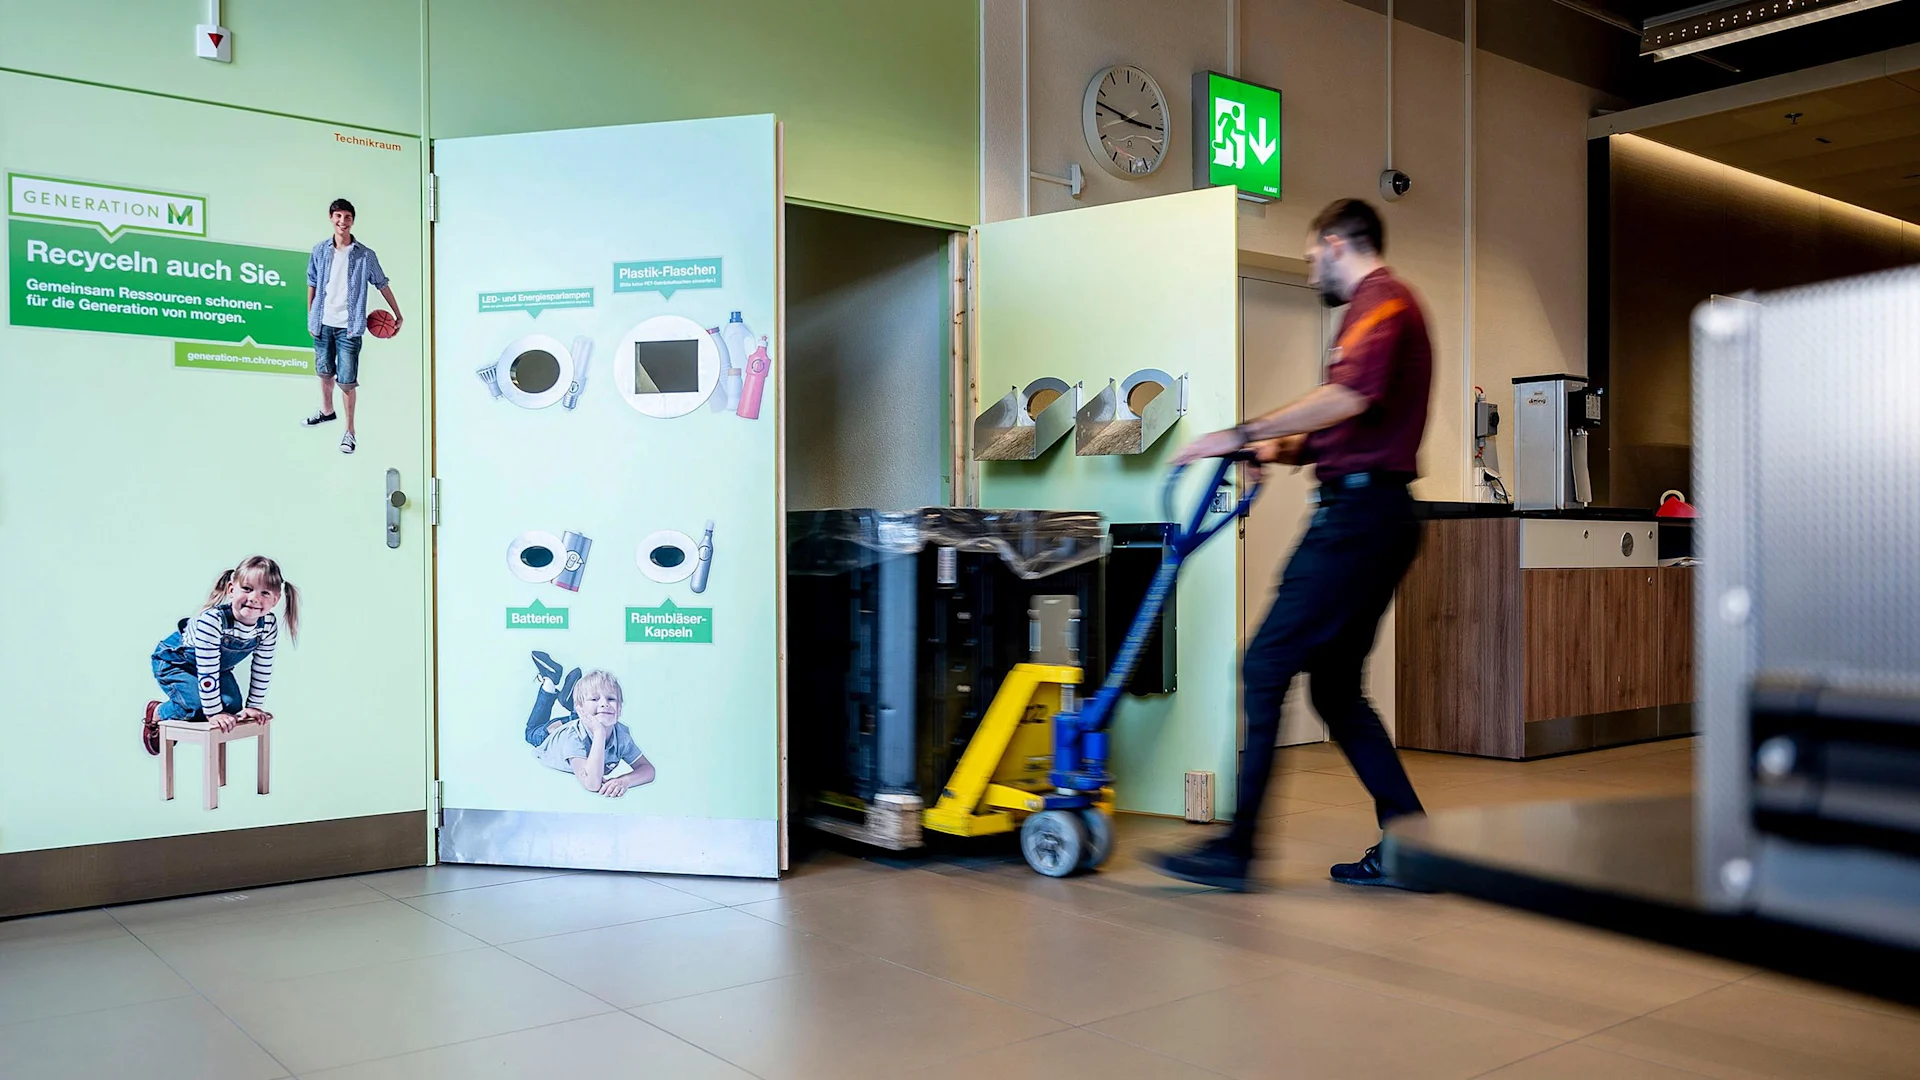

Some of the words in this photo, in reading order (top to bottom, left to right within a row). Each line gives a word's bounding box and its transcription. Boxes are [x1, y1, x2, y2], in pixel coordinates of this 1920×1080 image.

[334, 133, 402, 151] Technikraum
[23, 190, 160, 218] GENERATION
[167, 202, 193, 226] M
[27, 239, 159, 274] Recyceln
[166, 259, 232, 282] auch
[239, 262, 287, 287] Sie.
[619, 264, 717, 280] Plastik-Flaschen
[26, 277, 115, 298] Gemeinsam
[119, 286, 202, 305] Ressourcen
[205, 296, 262, 311] schonen
[481, 295, 501, 304] LED-
[502, 295, 517, 303] und
[518, 291, 590, 303] Energiesparlampen
[26, 293, 49, 308] für
[51, 296, 75, 310] die
[78, 298, 159, 317] Generation
[161, 306, 187, 319] von
[190, 309, 247, 325] morgen.
[187, 352, 309, 369] generation-m.ch/recycling
[511, 612, 564, 624] Batterien
[631, 612, 707, 625] Rahmbläser-
[645, 625, 693, 640] Kapseln
